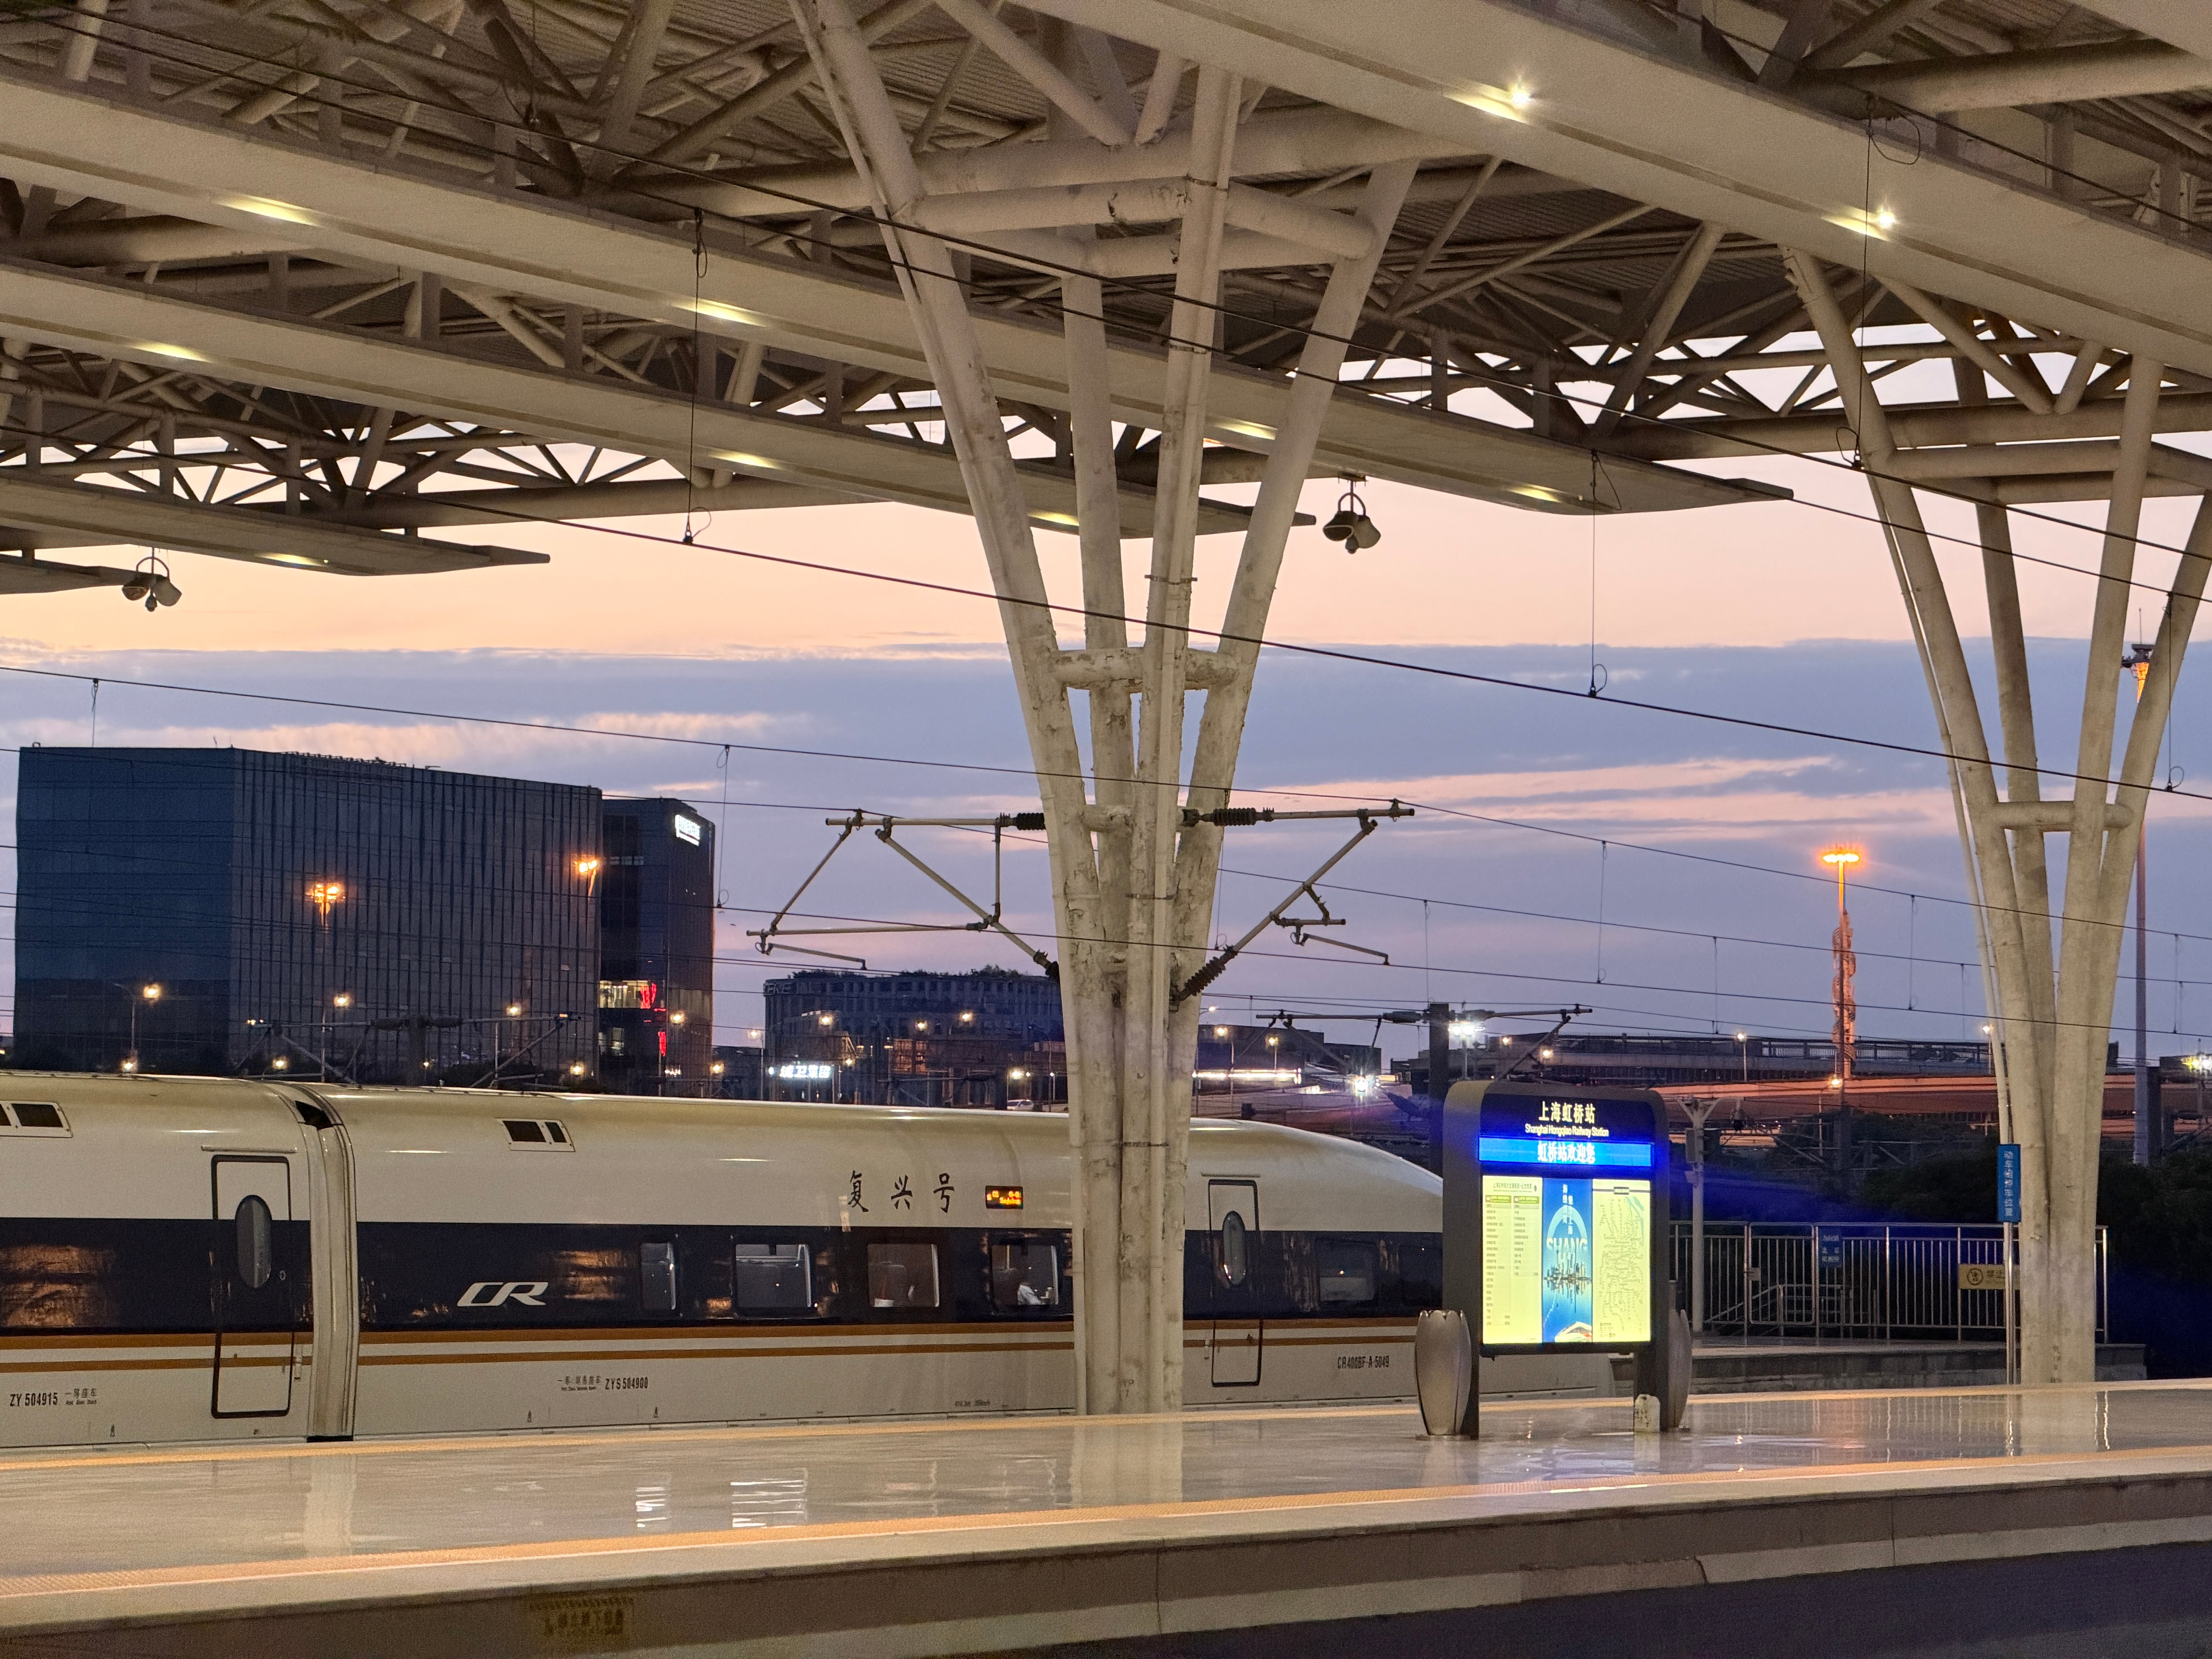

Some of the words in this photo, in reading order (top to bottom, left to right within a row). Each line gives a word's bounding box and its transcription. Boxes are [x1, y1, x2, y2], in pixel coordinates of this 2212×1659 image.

[1539, 1101, 1595, 1123] 上海虹桥站
[1525, 1123, 1549, 1136] Shanghai
[1549, 1125, 1571, 1137] Hongqiao
[1572, 1125, 1591, 1138] Railway
[1592, 1127, 1609, 1137] Station
[1537, 1140, 1595, 1164] 虹桥站欢迎您
[847, 1170, 955, 1213] 复兴号
[457, 1282, 549, 1307] CR
[10, 1394, 22, 1407] ZY
[25, 1392, 58, 1406] 504915
